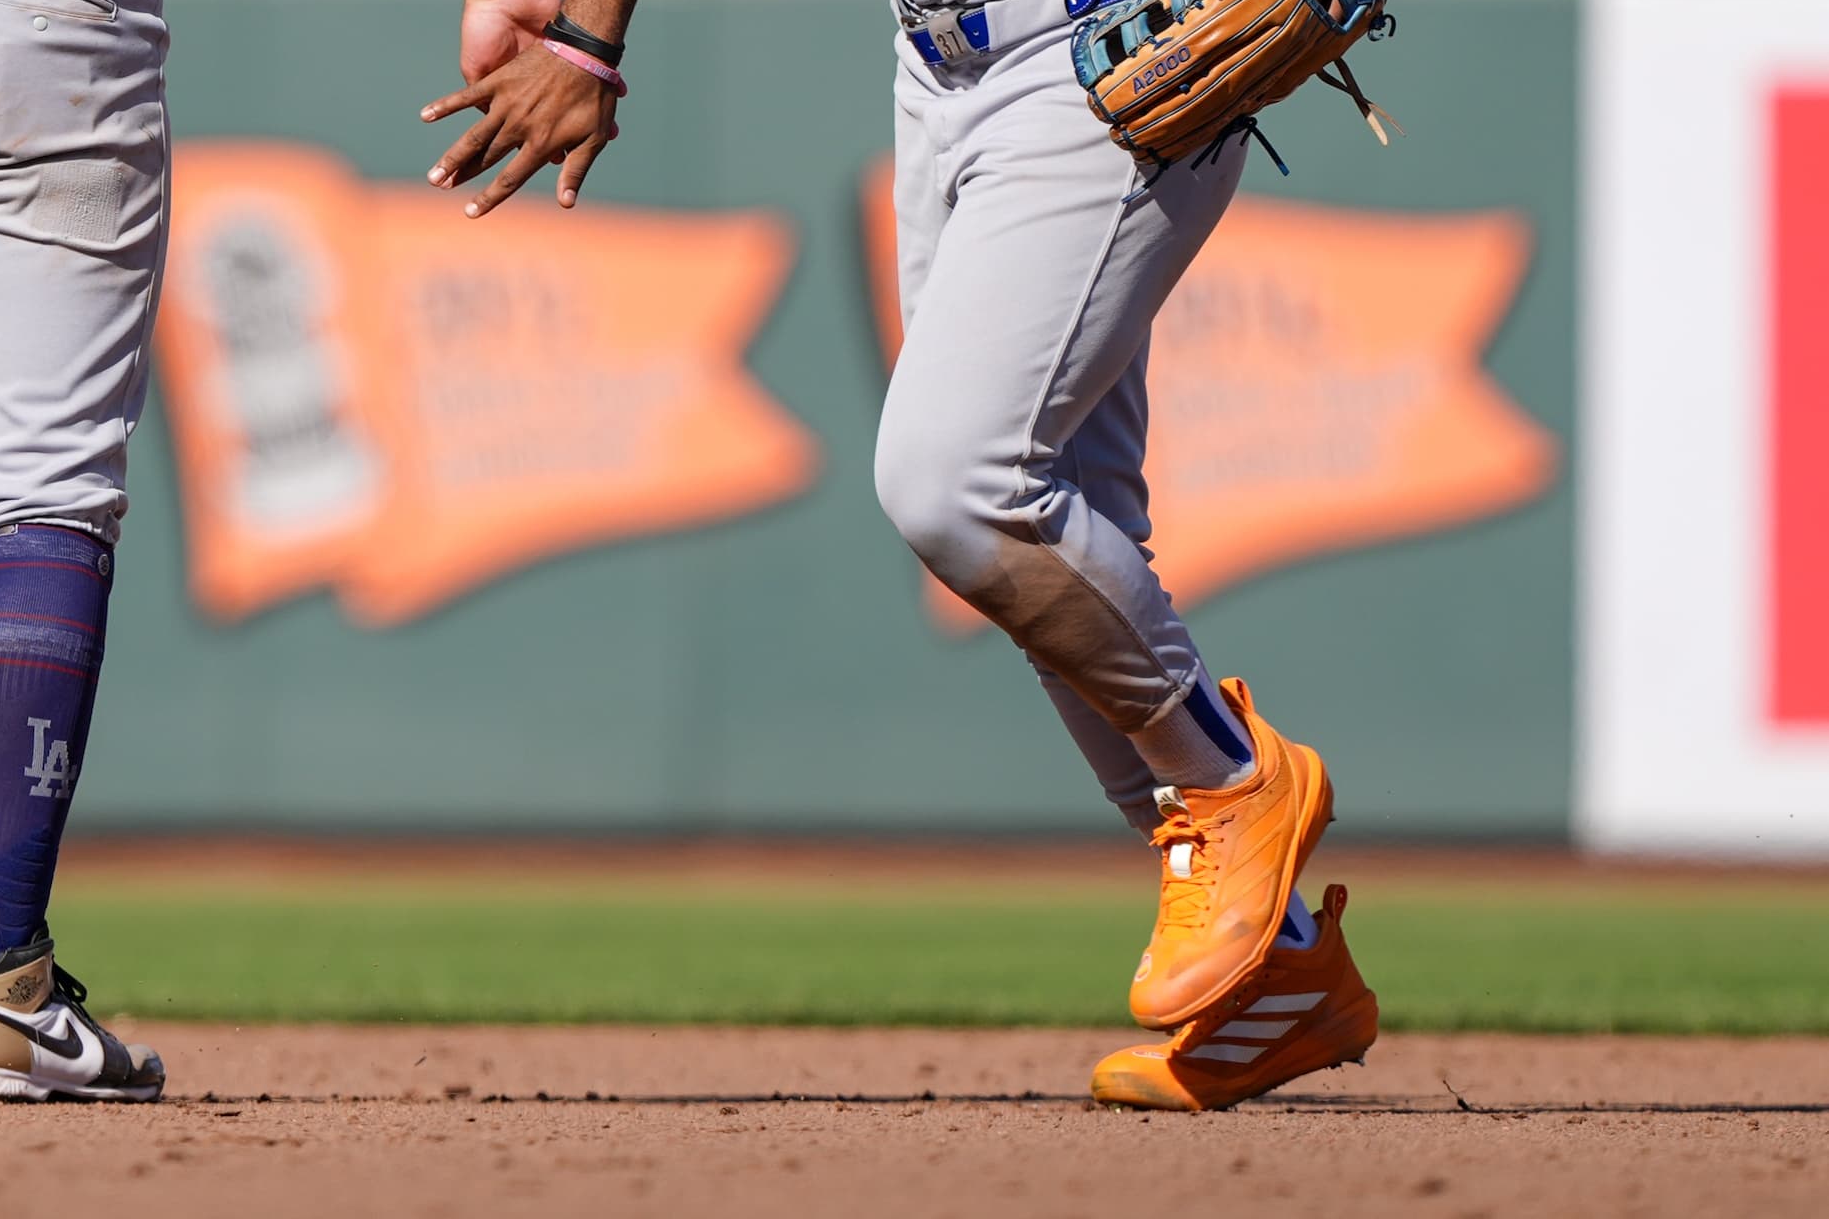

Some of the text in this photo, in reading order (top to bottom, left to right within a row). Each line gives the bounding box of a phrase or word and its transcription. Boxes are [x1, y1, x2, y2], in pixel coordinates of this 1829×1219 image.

[936, 31, 963, 59] 37
[1132, 45, 1191, 94] A2000
[24, 716, 73, 798] LA
